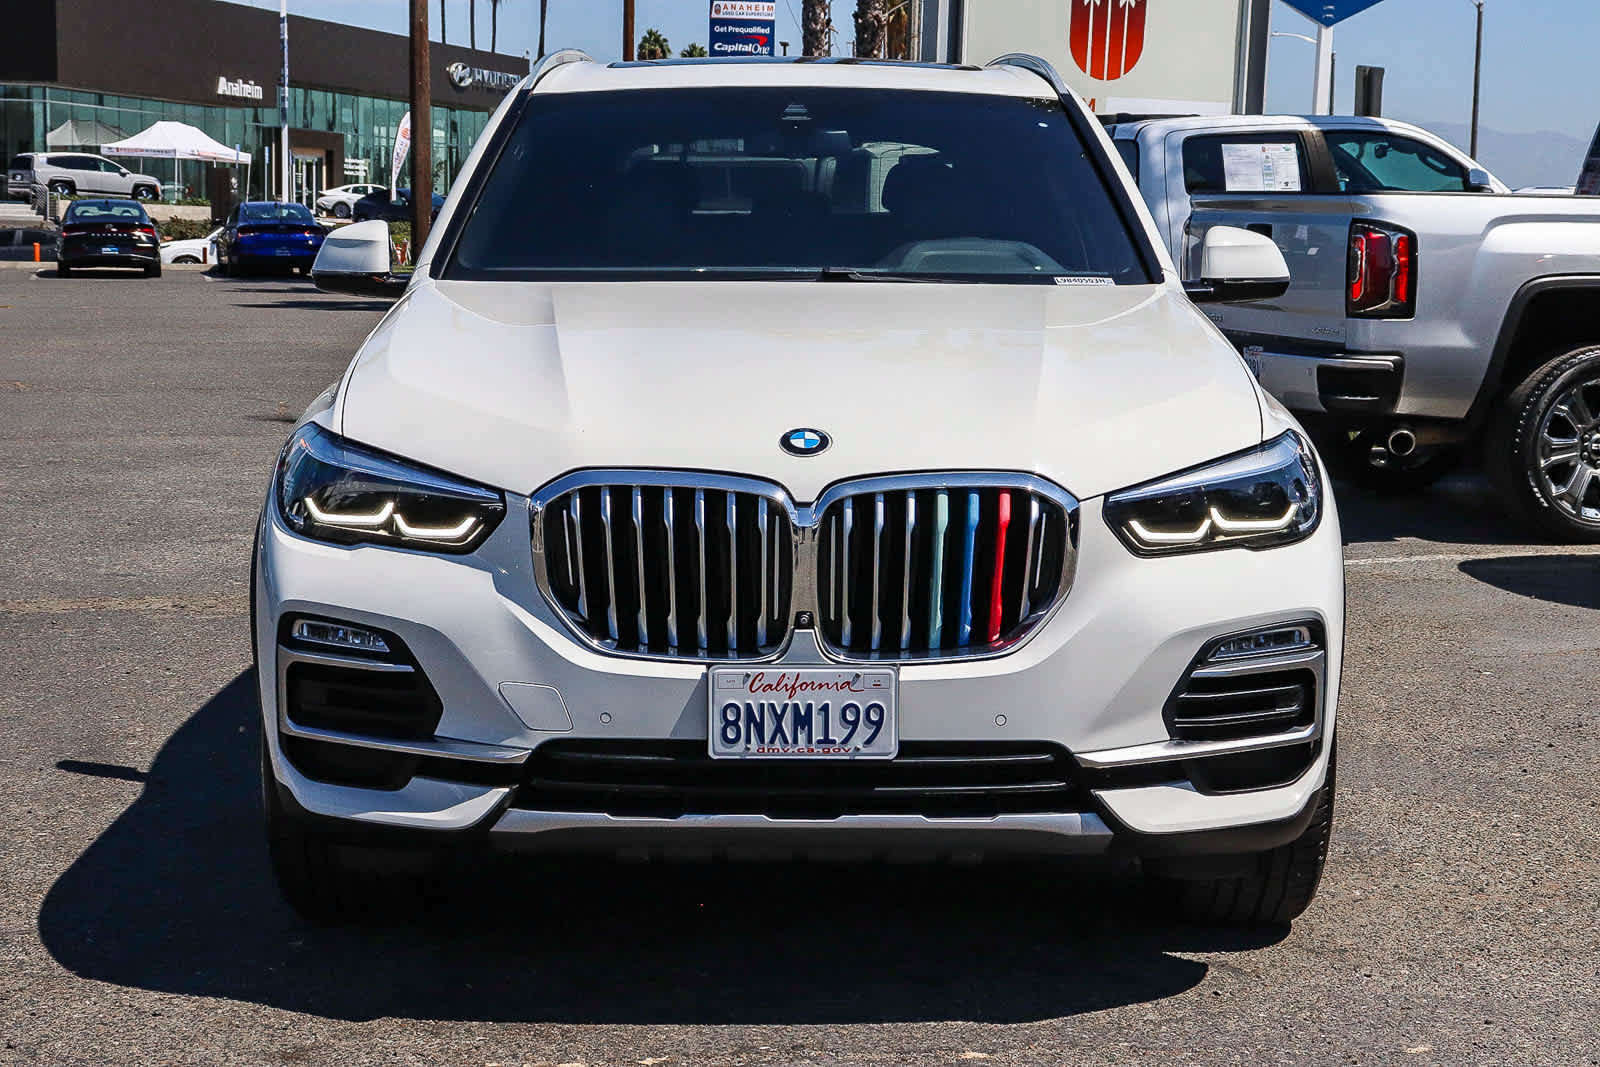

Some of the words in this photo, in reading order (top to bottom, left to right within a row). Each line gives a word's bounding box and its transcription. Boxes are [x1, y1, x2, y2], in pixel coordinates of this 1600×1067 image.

[723, 3, 773, 11] ANAHEIM
[728, 26, 770, 34] Prequalified
[217, 75, 263, 100] Anaheim
[749, 671, 865, 699] California
[721, 702, 885, 746] 8NXM199
[756, 746, 851, 754] dmv.ca.gov
